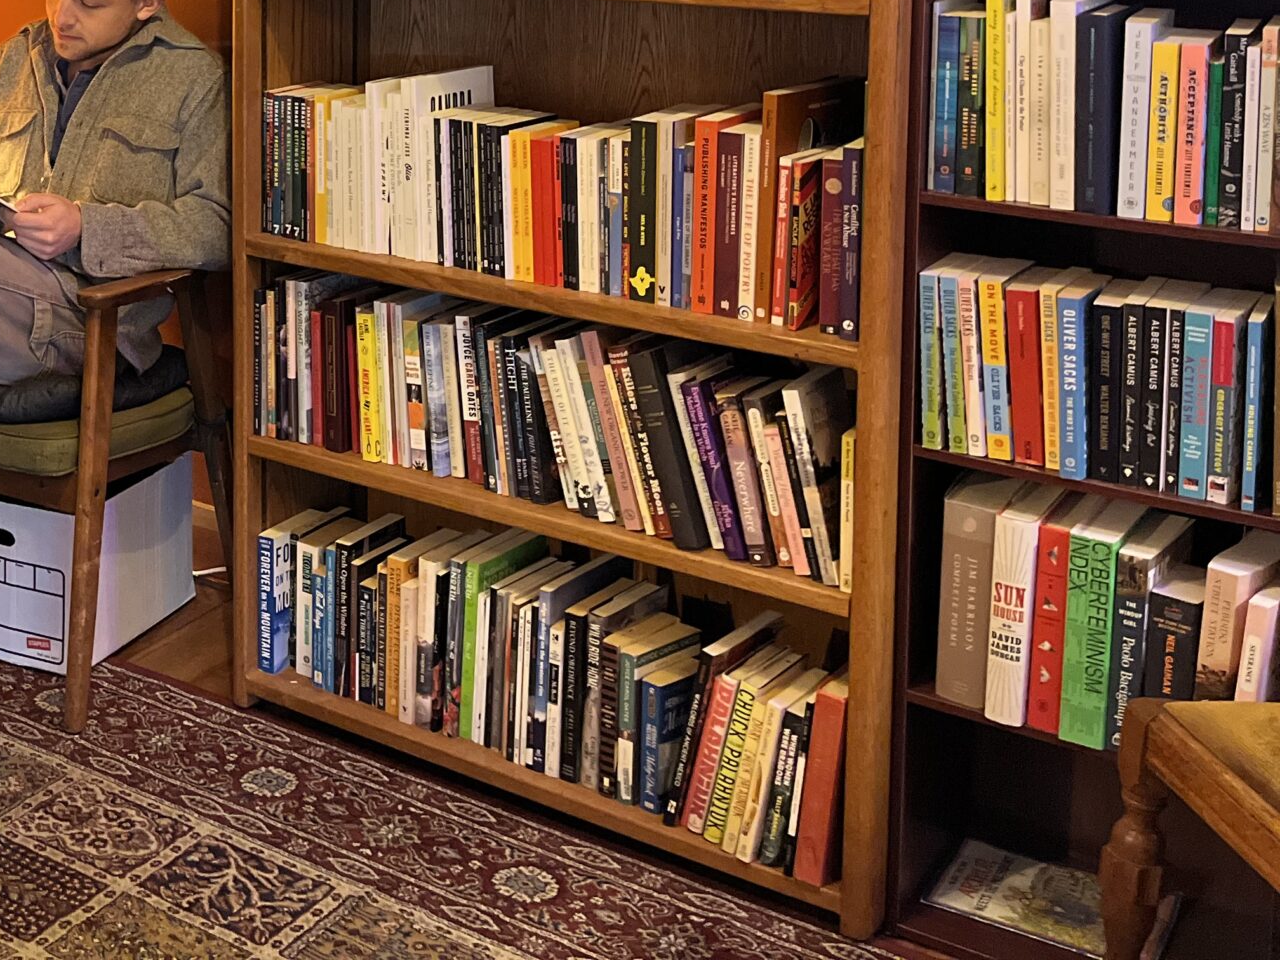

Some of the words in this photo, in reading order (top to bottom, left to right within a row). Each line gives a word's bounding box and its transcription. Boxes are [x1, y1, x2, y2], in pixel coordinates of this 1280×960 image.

[1157, 75, 1170, 143] AUTHORITY
[1185, 69, 1197, 146] ACCEPTANCE
[700, 137, 710, 191] PUBLISHING
[699, 194, 709, 249] MANIFESTOS
[744, 204, 753, 229] LIFE
[849, 204, 859, 236] Conflict
[742, 252, 751, 295] POETRY
[987, 284, 995, 297] ON
[960, 288, 972, 312] OLIVER
[988, 304, 997, 324] THE
[962, 314, 974, 337] SACKS
[1063, 309, 1076, 350] OLIVER
[1150, 320, 1159, 355] ALBERT
[462, 333, 472, 360] JOYCE
[989, 329, 999, 361] MOVE
[465, 362, 473, 390] CAROL
[505, 348, 517, 392] FLIGHT
[1063, 354, 1076, 391] SACKS
[1149, 357, 1158, 390] CAMUS
[467, 392, 476, 418] OATES
[521, 382, 532, 423] FAULTLINE
[1183, 356, 1194, 424] ACTIVISM
[550, 430, 566, 464] dirt
[621, 367, 638, 410] Killers
[638, 432, 656, 477] Flower
[649, 479, 665, 515] Moon
[614, 457, 628, 491] GROWER
[732, 460, 757, 533] Neverwhere
[261, 550, 272, 592] FOREVER
[952, 554, 961, 608] COMPLETE
[968, 557, 978, 580] JIM
[1069, 536, 1089, 595] INDEX
[993, 582, 1026, 607] SUN
[340, 606, 348, 636] Window
[965, 586, 977, 652] HARRISON
[992, 605, 1024, 623] HOUSE
[1084, 542, 1111, 694] CYBERFEMINISM
[261, 611, 271, 658] MOUNTAIN
[589, 623, 600, 647] WILD
[990, 640, 1022, 655] JAMES
[991, 631, 1022, 645] DAVID
[1166, 634, 1175, 653] NEIL
[990, 650, 1021, 663] DUNCAN
[1120, 637, 1135, 668] Paolo
[1245, 645, 1256, 684] SEVERANCE
[566, 654, 576, 700] OBEDIENCE
[586, 667, 598, 690] HOME
[1162, 656, 1174, 694] GAIMAN
[688, 693, 700, 727] WARLORDS
[728, 689, 755, 739] CHUCK
[787, 734, 798, 757] WHEN
[775, 751, 789, 786] DRAGONS
[783, 758, 796, 786] WOMEN
[706, 745, 743, 831] PALAHNIUK
